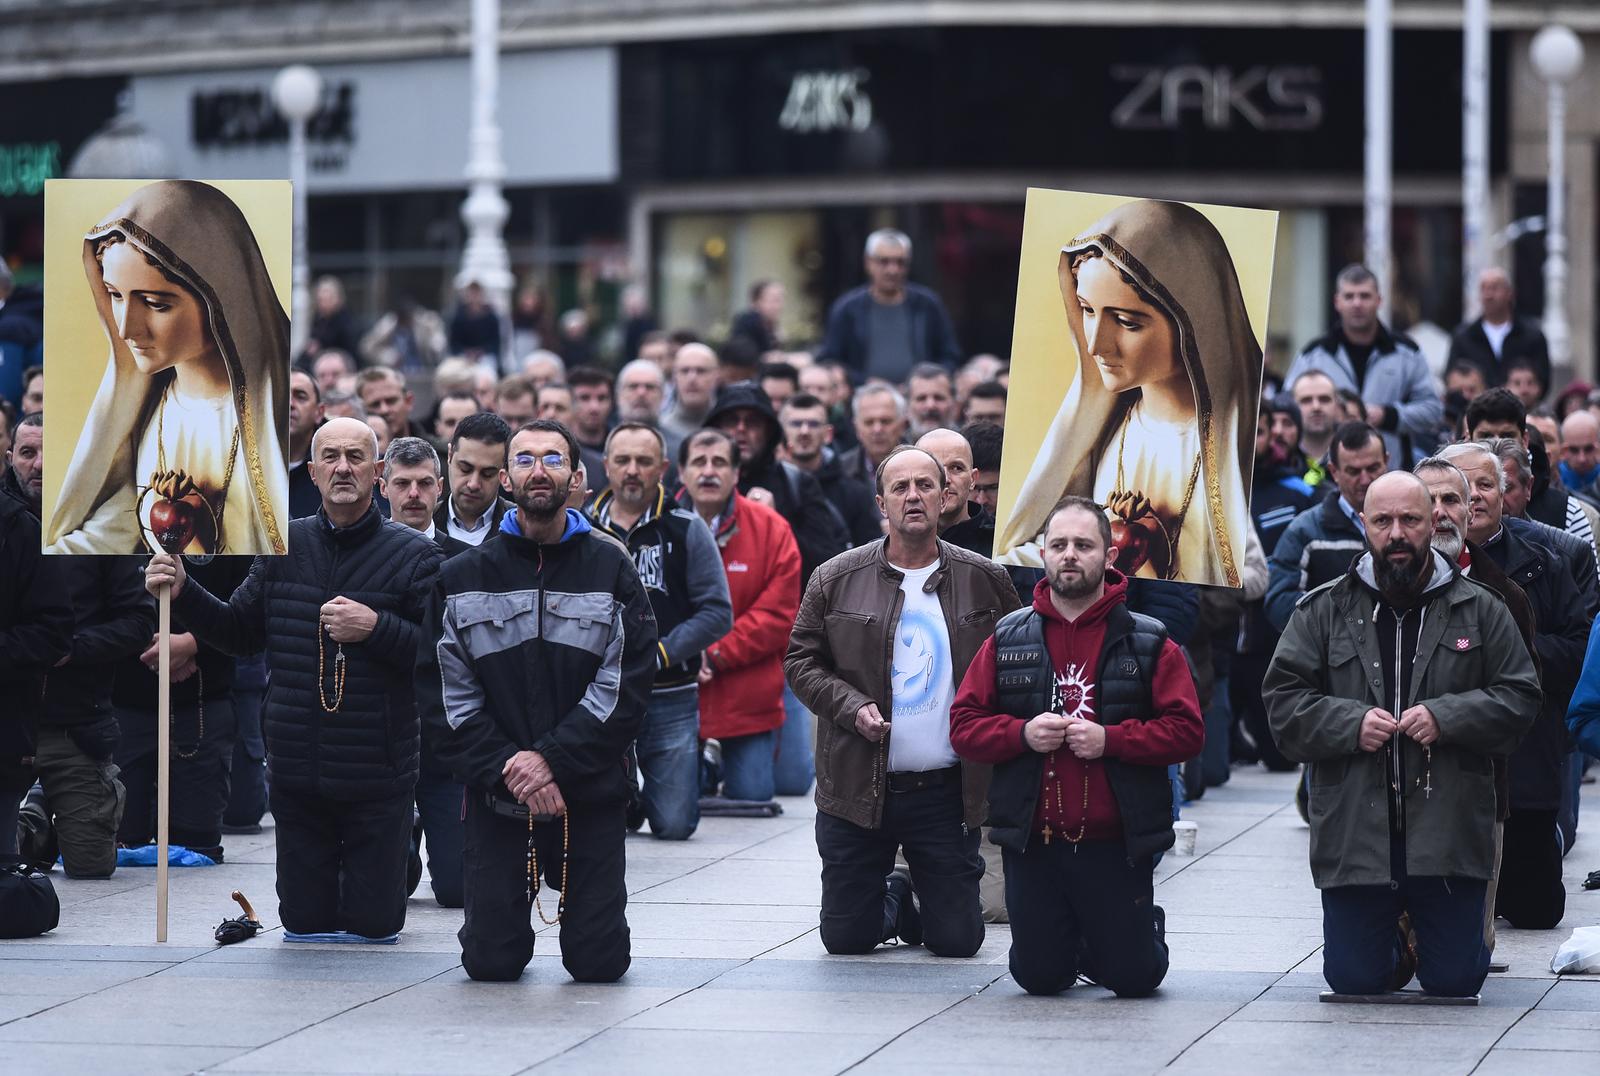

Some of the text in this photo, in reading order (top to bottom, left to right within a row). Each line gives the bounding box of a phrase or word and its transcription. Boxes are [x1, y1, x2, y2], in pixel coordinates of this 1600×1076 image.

[1109, 64, 1323, 130] ZAKS
[997, 652, 1039, 661] PHILIPP
[1000, 676, 1031, 686] PLEIN
